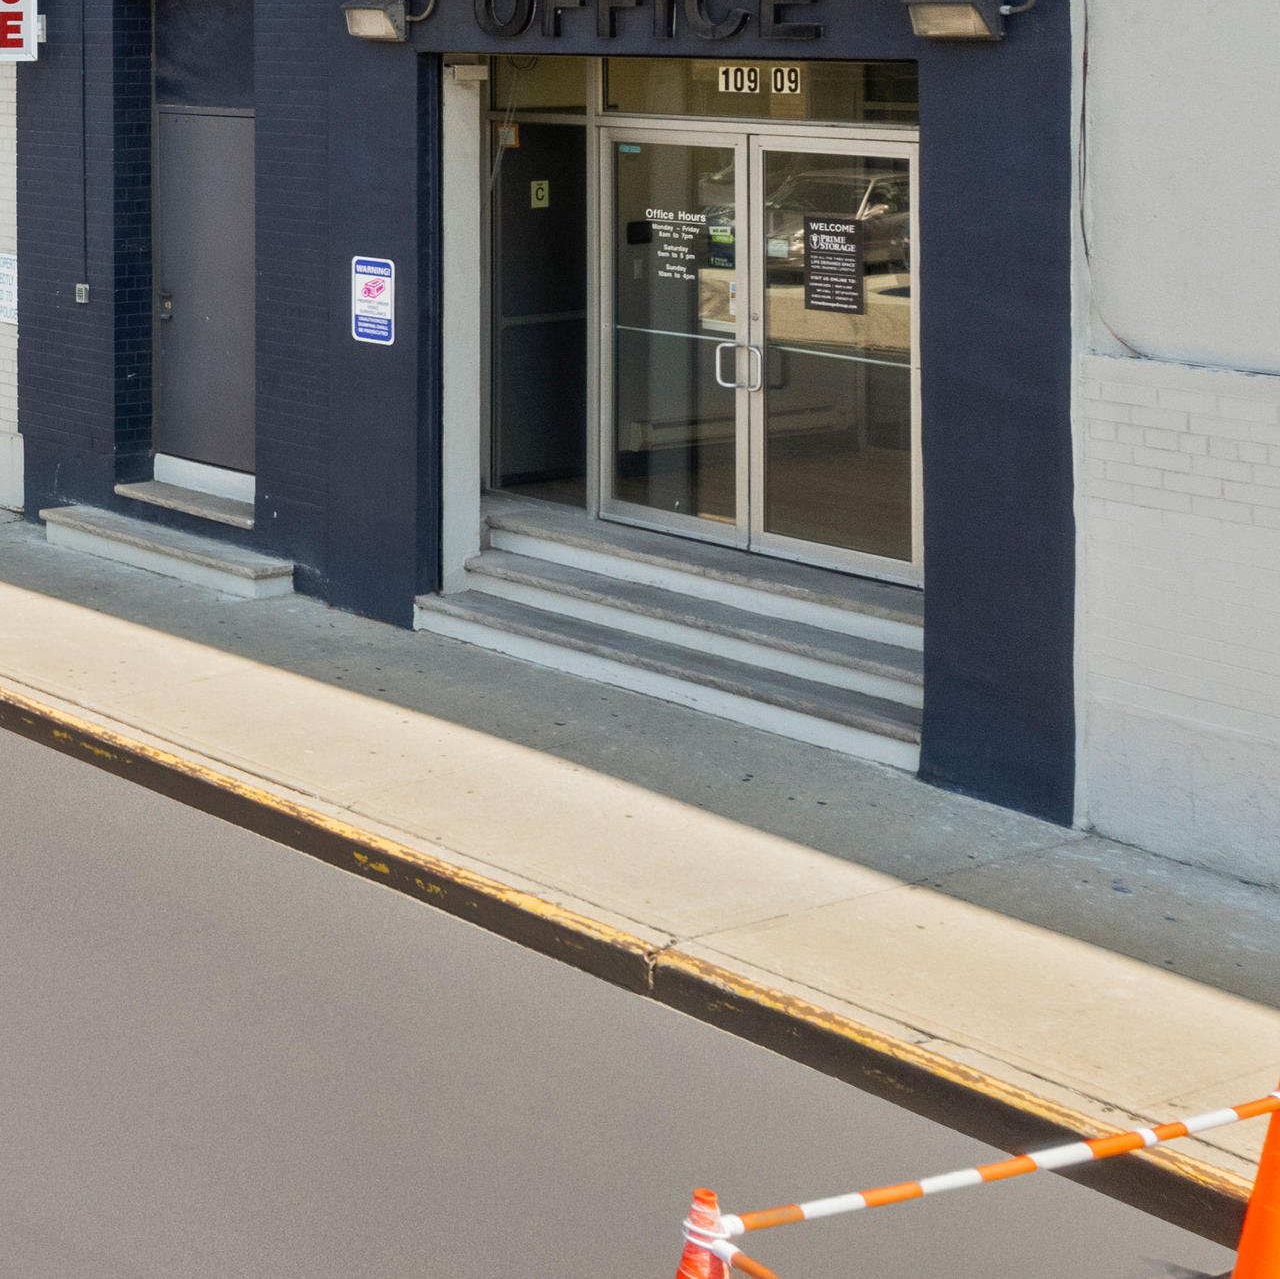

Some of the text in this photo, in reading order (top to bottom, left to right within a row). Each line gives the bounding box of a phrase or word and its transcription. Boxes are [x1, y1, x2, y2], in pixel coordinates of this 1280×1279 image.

[721, 67, 800, 92] 109 09
[536, 186, 544, 201] C
[645, 208, 706, 222] Office Hours
[652, 223, 673, 231] Monday
[682, 225, 700, 233] Friday
[809, 222, 855, 233] WELCOME
[820, 234, 847, 244] PRIME
[663, 244, 688, 253] Saturday
[820, 242, 856, 252] STORAGE
[356, 264, 391, 276] WARNING!
[665, 264, 686, 272] Sunday
